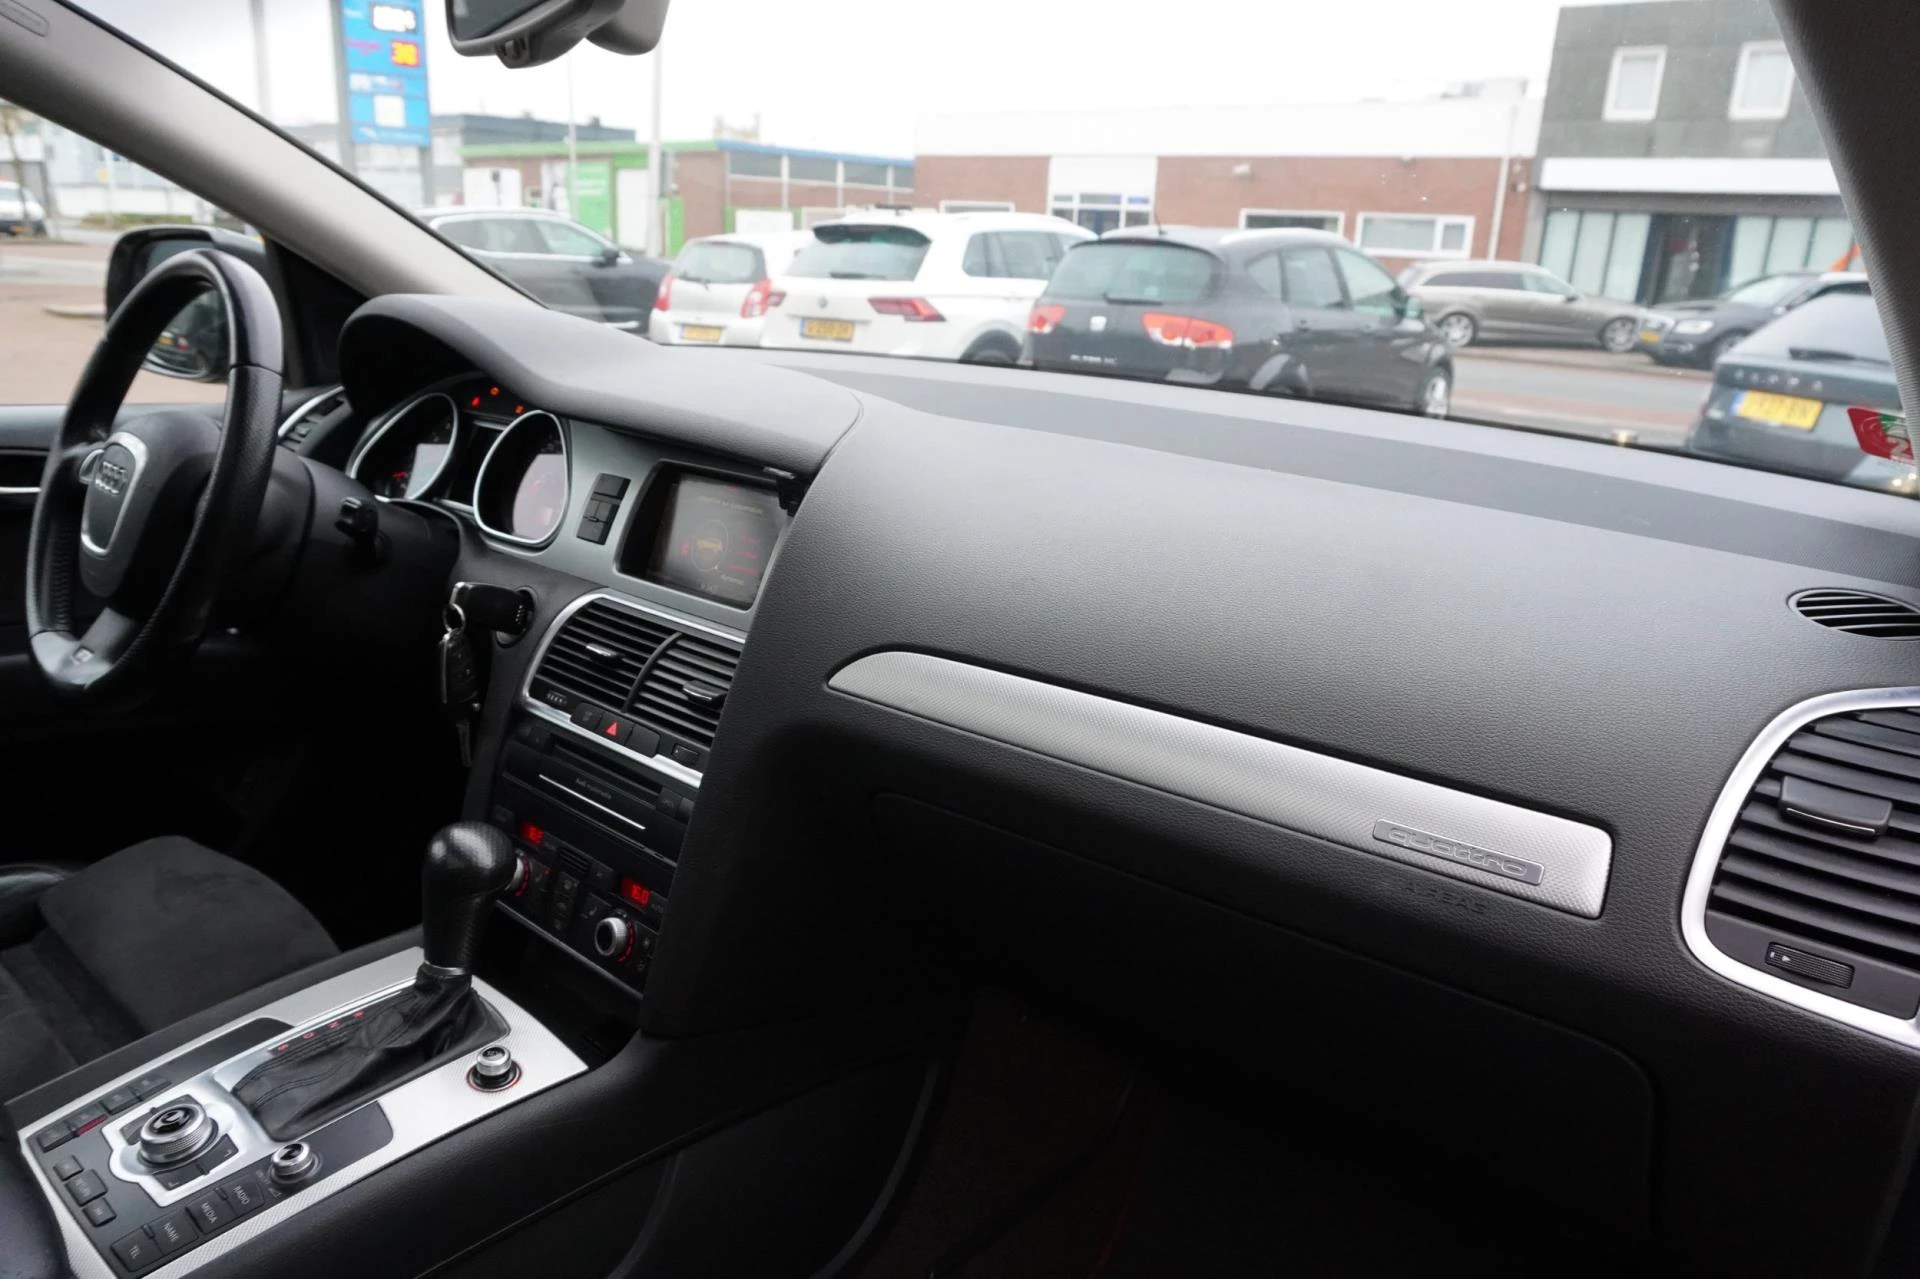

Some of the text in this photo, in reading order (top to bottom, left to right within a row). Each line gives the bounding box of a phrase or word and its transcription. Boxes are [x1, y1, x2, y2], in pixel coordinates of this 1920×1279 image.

[1388, 827, 1528, 877] quattro
[232, 1184, 251, 1205] RADIO
[200, 1202, 219, 1224] MEDIA
[128, 1244, 142, 1260] TEL
